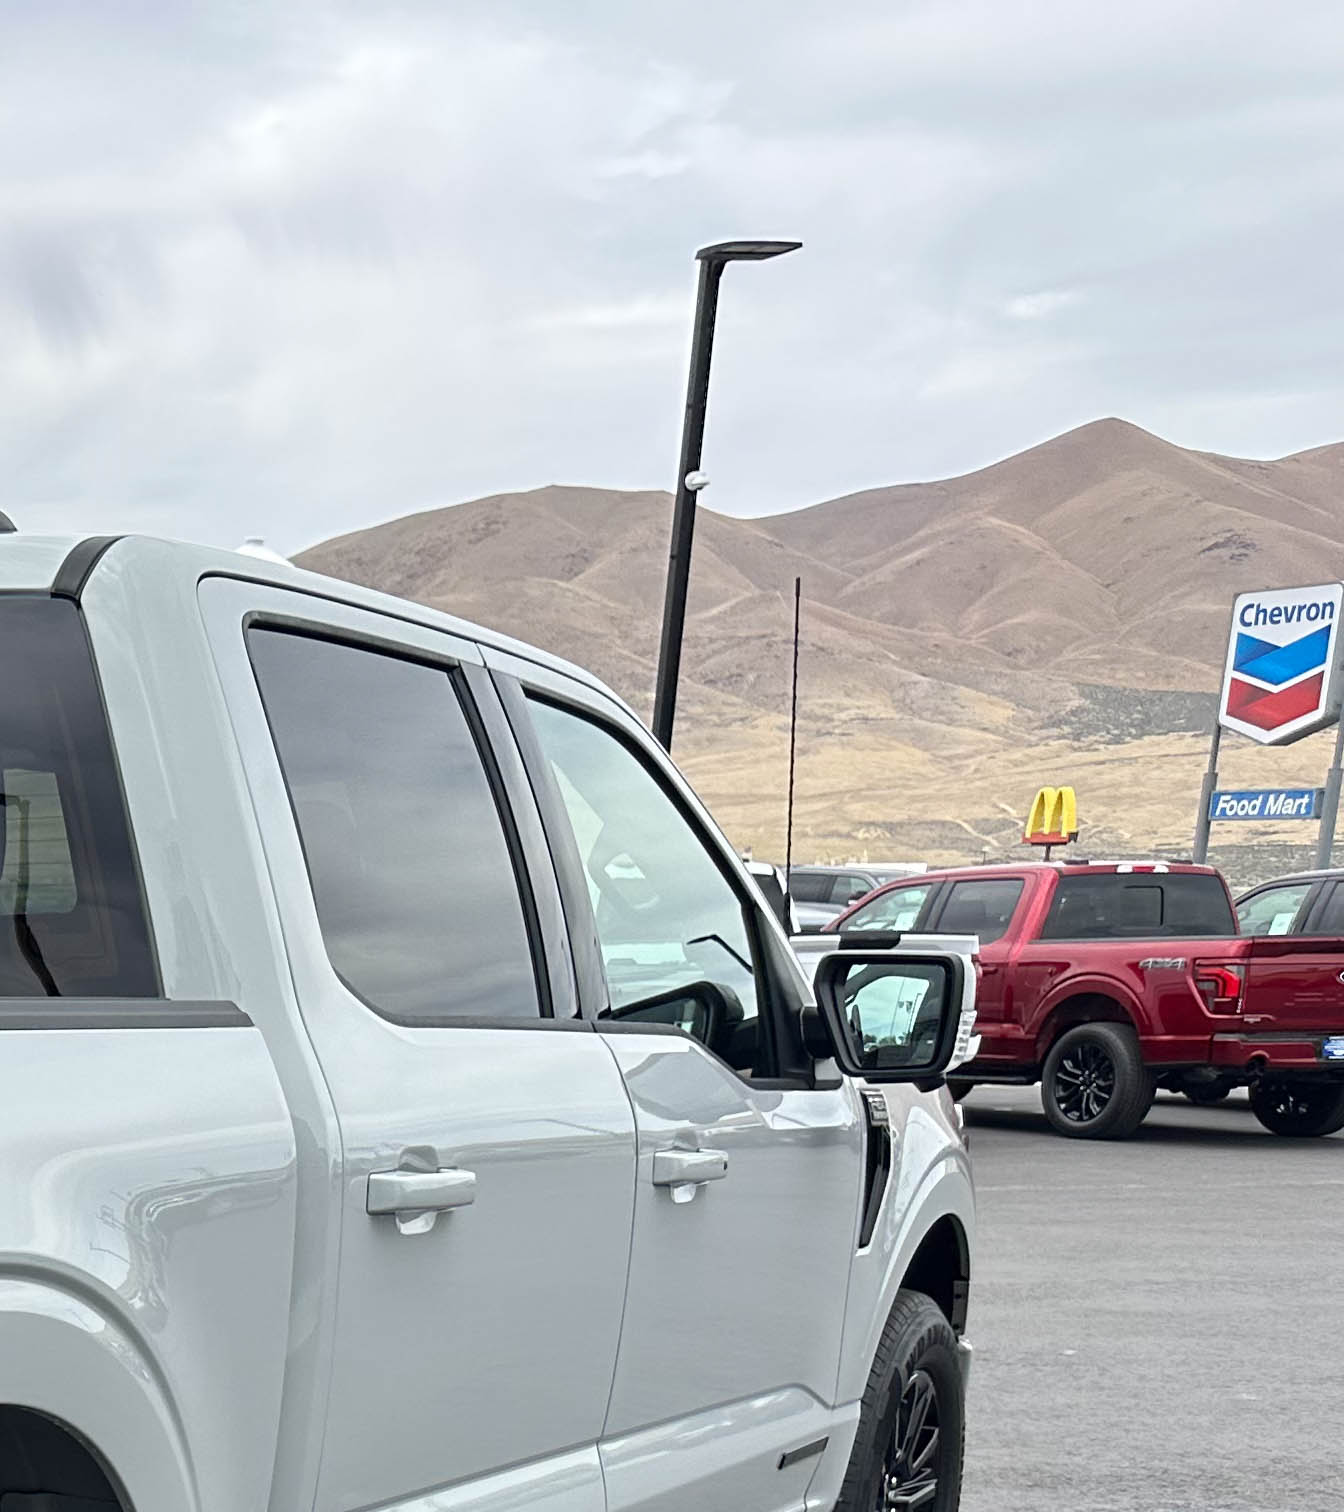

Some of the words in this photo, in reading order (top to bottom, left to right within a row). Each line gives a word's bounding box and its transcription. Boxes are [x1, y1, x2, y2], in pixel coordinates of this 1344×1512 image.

[1239, 600, 1335, 627] Chevron
[1215, 793, 1262, 816] Food
[1264, 792, 1309, 815] Mart
